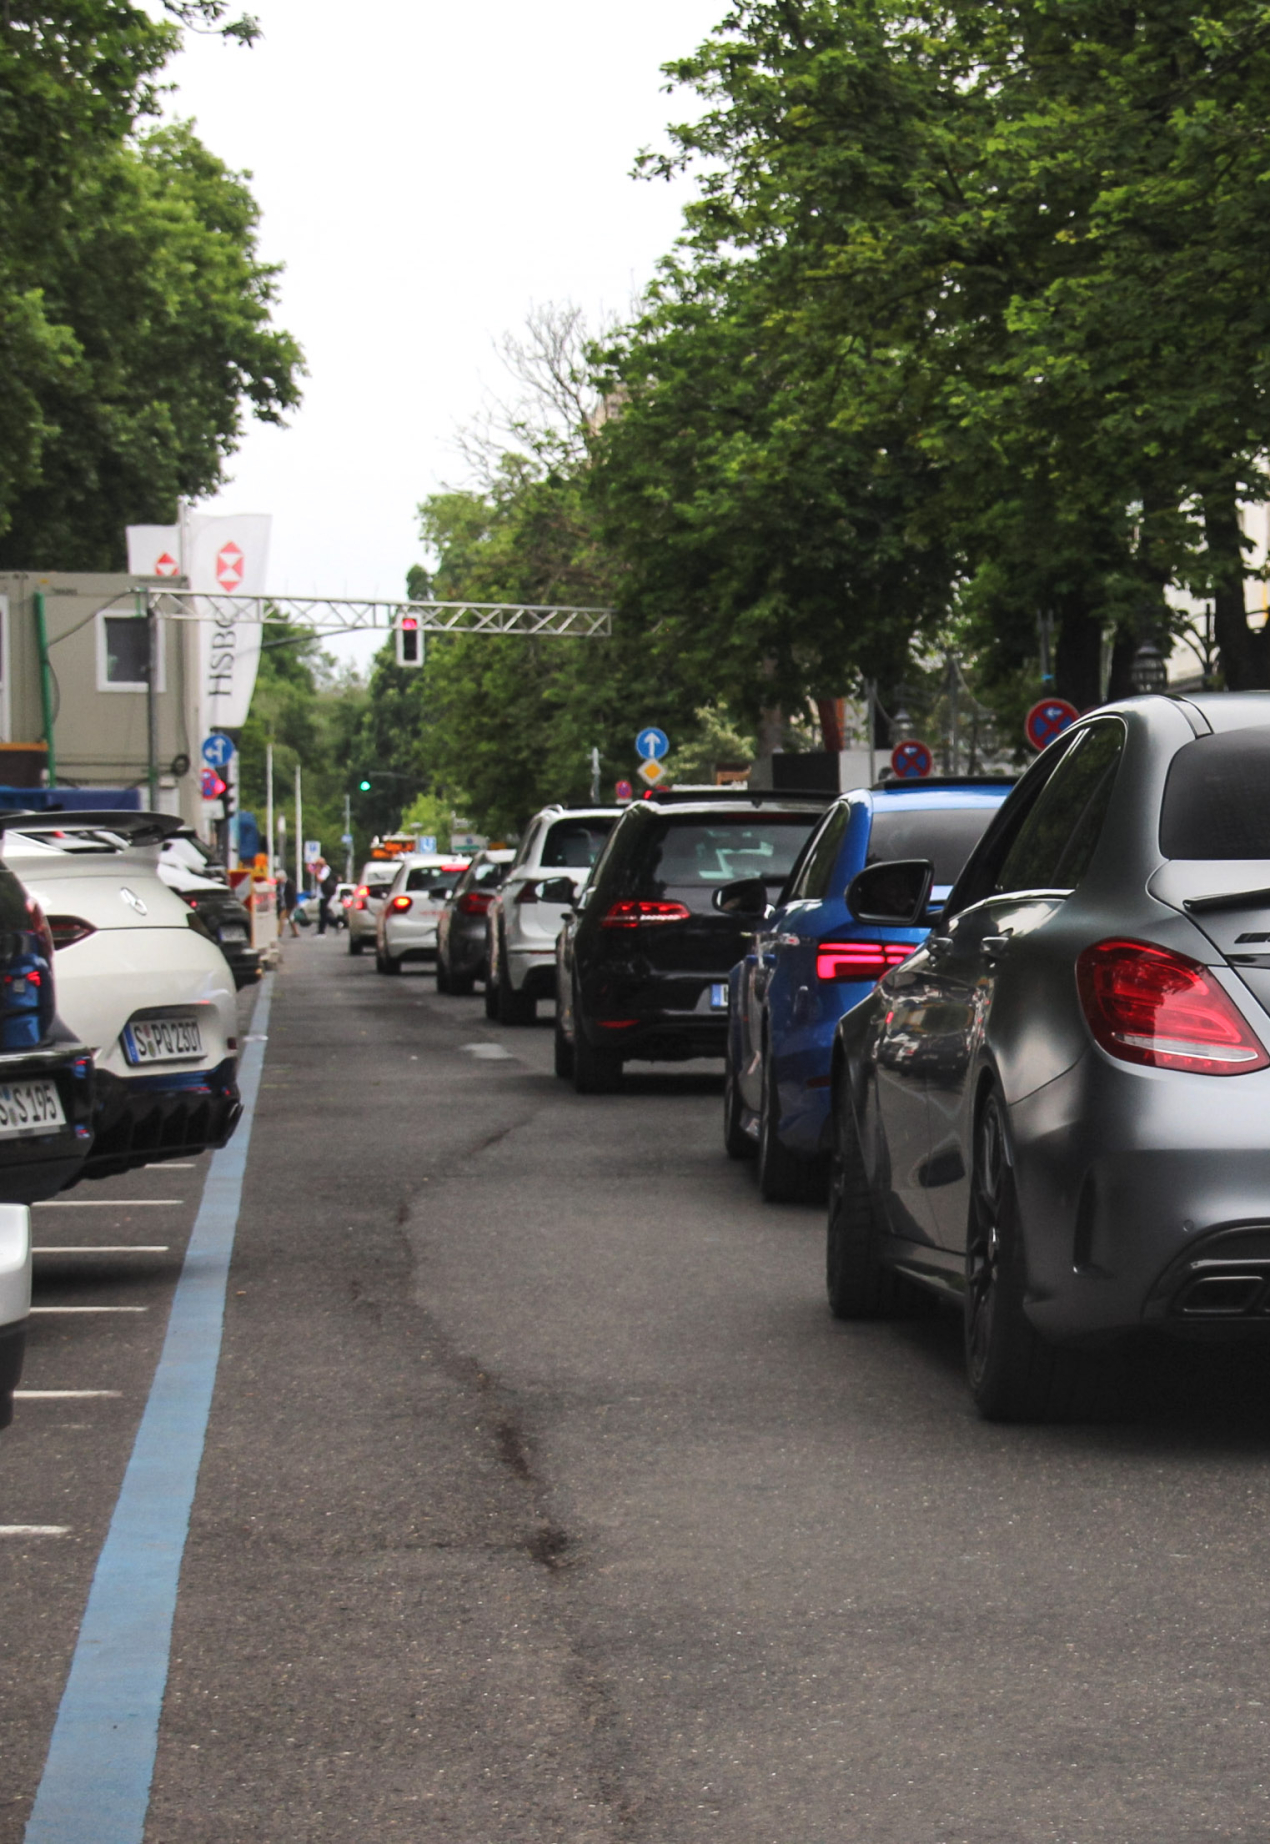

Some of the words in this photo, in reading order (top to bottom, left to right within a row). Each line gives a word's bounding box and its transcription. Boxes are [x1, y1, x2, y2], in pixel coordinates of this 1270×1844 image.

[208, 608, 238, 696] HSBC
[133, 1026, 147, 1056] S
[13, 1087, 28, 1123] S
[26, 1085, 57, 1122] 195
